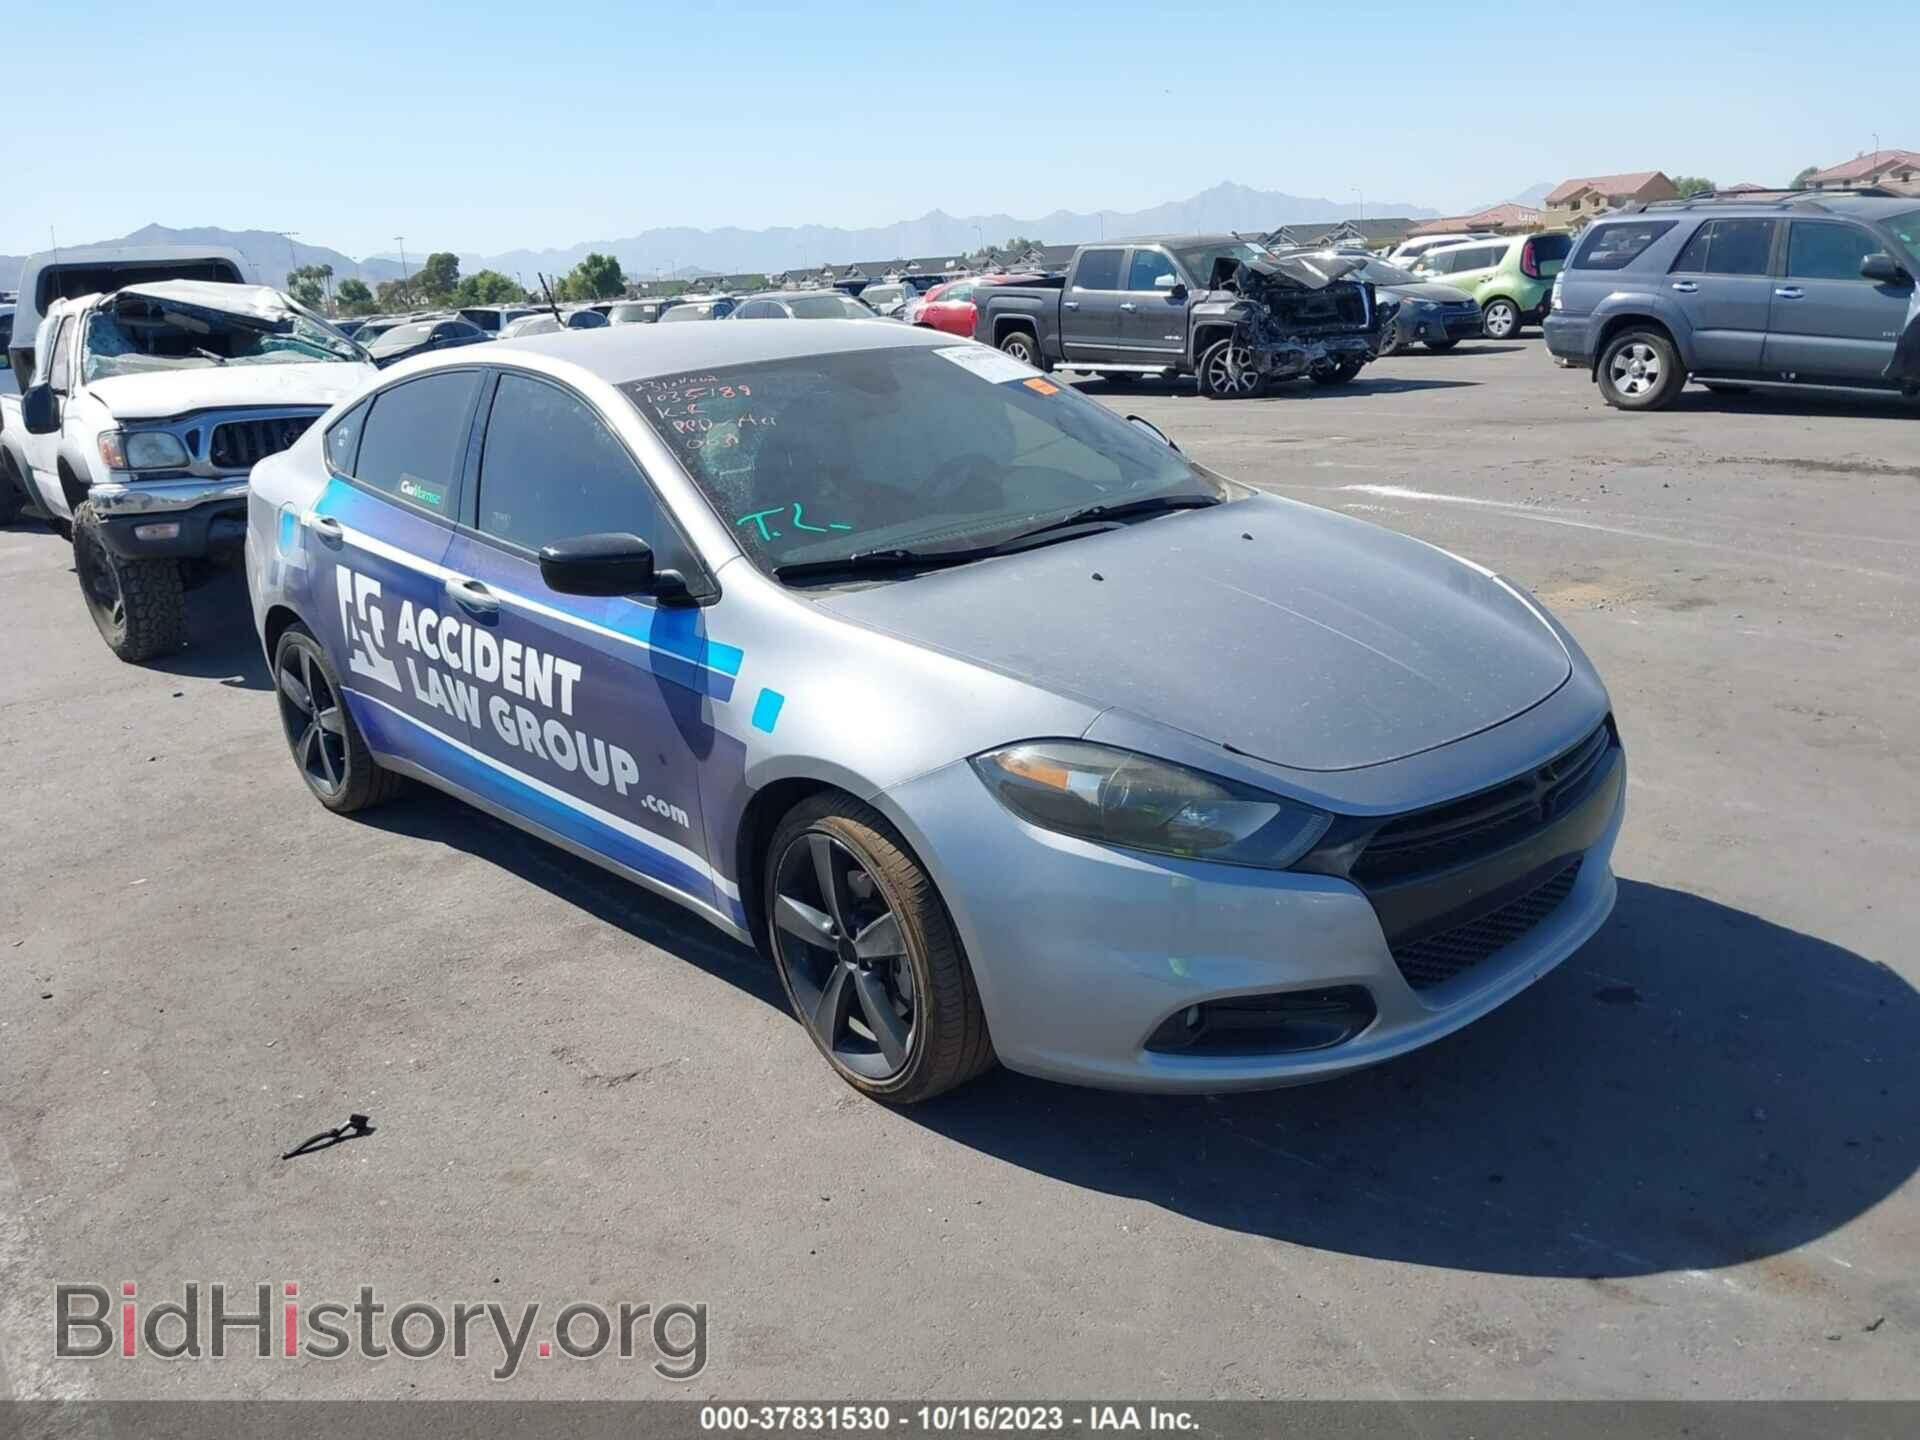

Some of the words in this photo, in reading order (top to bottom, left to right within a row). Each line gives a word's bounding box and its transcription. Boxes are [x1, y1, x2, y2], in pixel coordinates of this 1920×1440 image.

[397, 600, 582, 716] ACCIDENT
[406, 657, 482, 729] LAW
[489, 695, 640, 796] GROUP
[640, 794, 690, 828] .com
